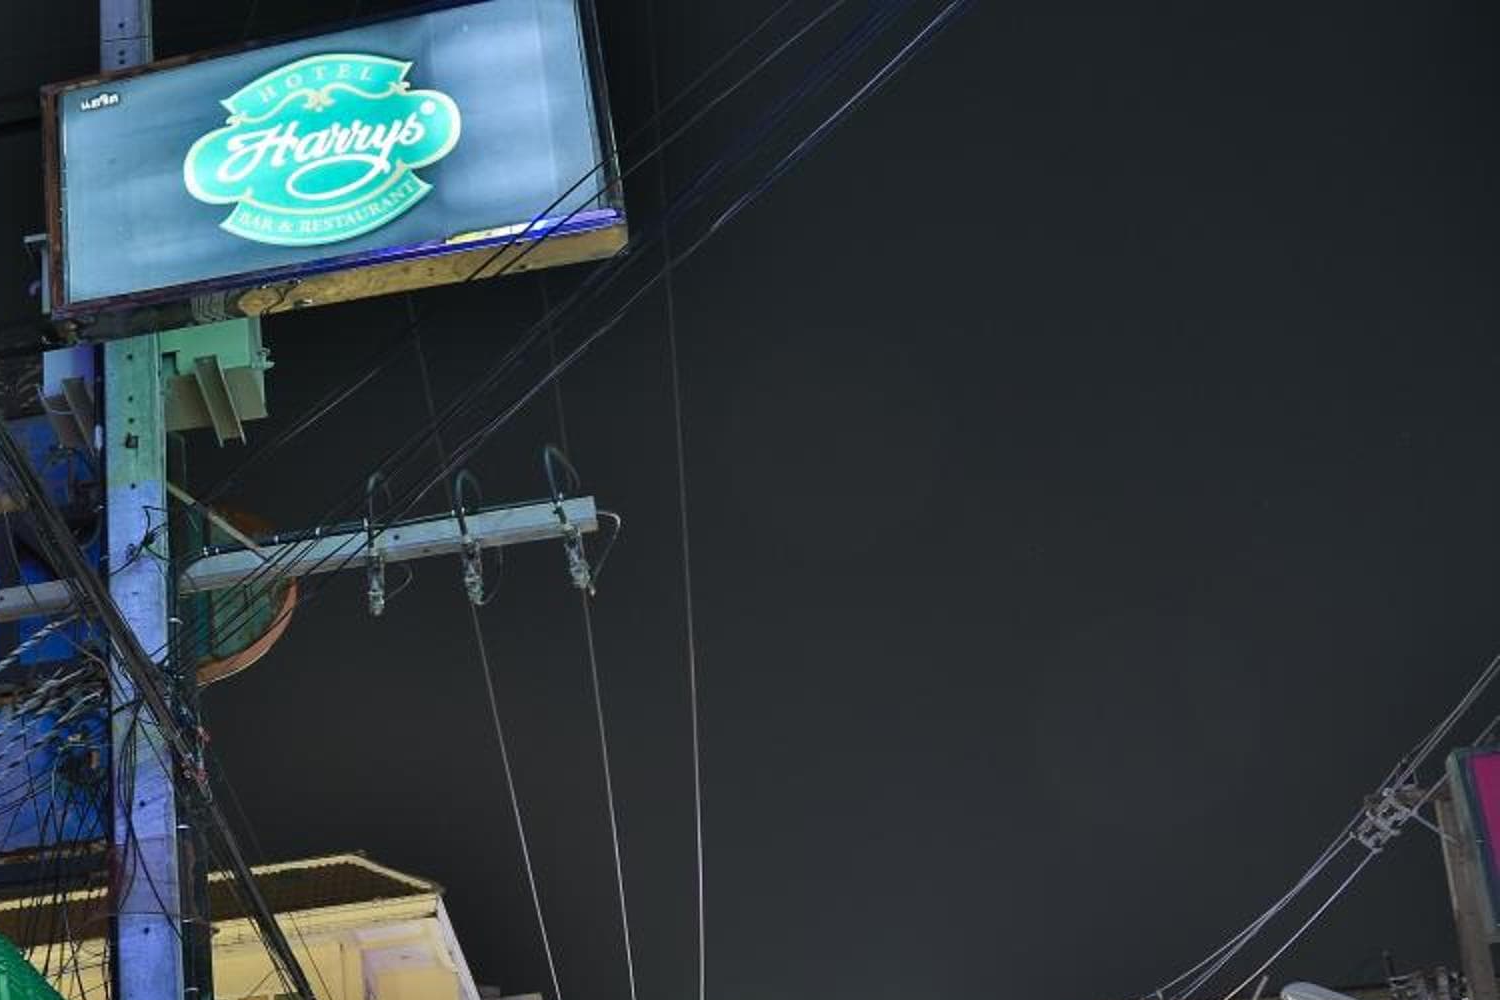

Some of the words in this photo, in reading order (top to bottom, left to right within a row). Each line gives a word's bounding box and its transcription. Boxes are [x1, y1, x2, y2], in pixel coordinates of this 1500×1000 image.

[260, 64, 372, 102] HOTEL
[240, 210, 274, 232] BAR
[276, 219, 294, 232] &
[301, 182, 416, 232] RESTAURANT
